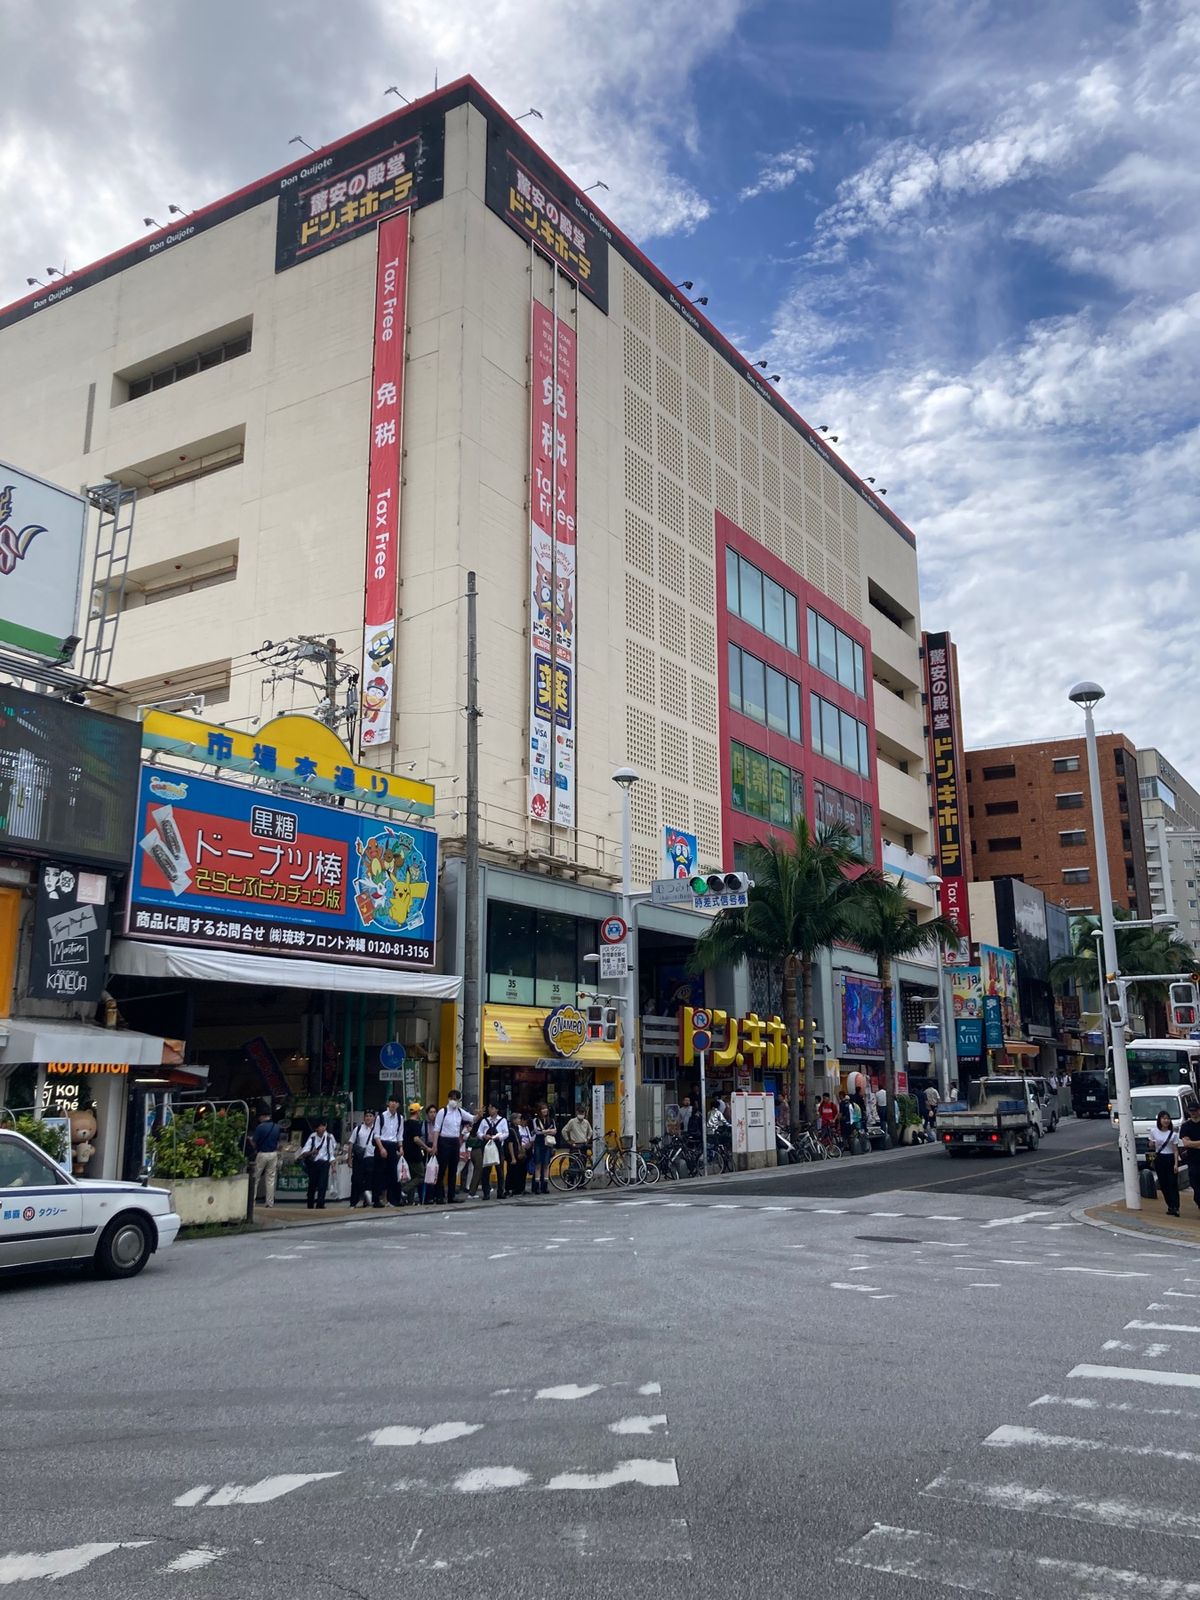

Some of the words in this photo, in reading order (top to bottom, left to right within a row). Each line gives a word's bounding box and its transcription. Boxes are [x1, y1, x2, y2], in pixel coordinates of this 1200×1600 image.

[280, 174, 298, 188] Don
[299, 157, 333, 178] Quijote
[575, 197, 589, 216] Don
[589, 213, 612, 239] Quijote
[150, 241, 165, 252] Don
[166, 225, 195, 244] Quijote
[383, 257, 399, 294] Tax
[33, 299, 47, 309] Don
[48, 285, 73, 302] Quijote
[669, 293, 681, 311] Don
[381, 297, 397, 342] Free
[374, 381, 398, 449] 免税
[542, 375, 568, 466] 免税
[535, 467, 566, 504] Tax
[375, 489, 391, 528] Tax
[539, 493, 575, 531] Free
[374, 532, 390, 580] Free
[534, 726, 548, 739] VISA
[207, 731, 389, 798] 市場本通り
[253, 810, 294, 839] 黒糖
[196, 829, 342, 887] ドーナツ棒
[195, 868, 341, 910] そらとぶピカチュウ版
[694, 894, 747, 908] 時差式信号機
[947, 881, 958, 904] Tax
[136, 911, 266, 941] 商品に関するお問合せ
[367, 940, 430, 958] 0120-81-3156
[508, 979, 516, 988] 35
[552, 984, 560, 993] 35
[55, 1099, 79, 1111] Thé
[56, 1085, 79, 1096] KOI
[39, 1207, 68, 1217] タクシー
